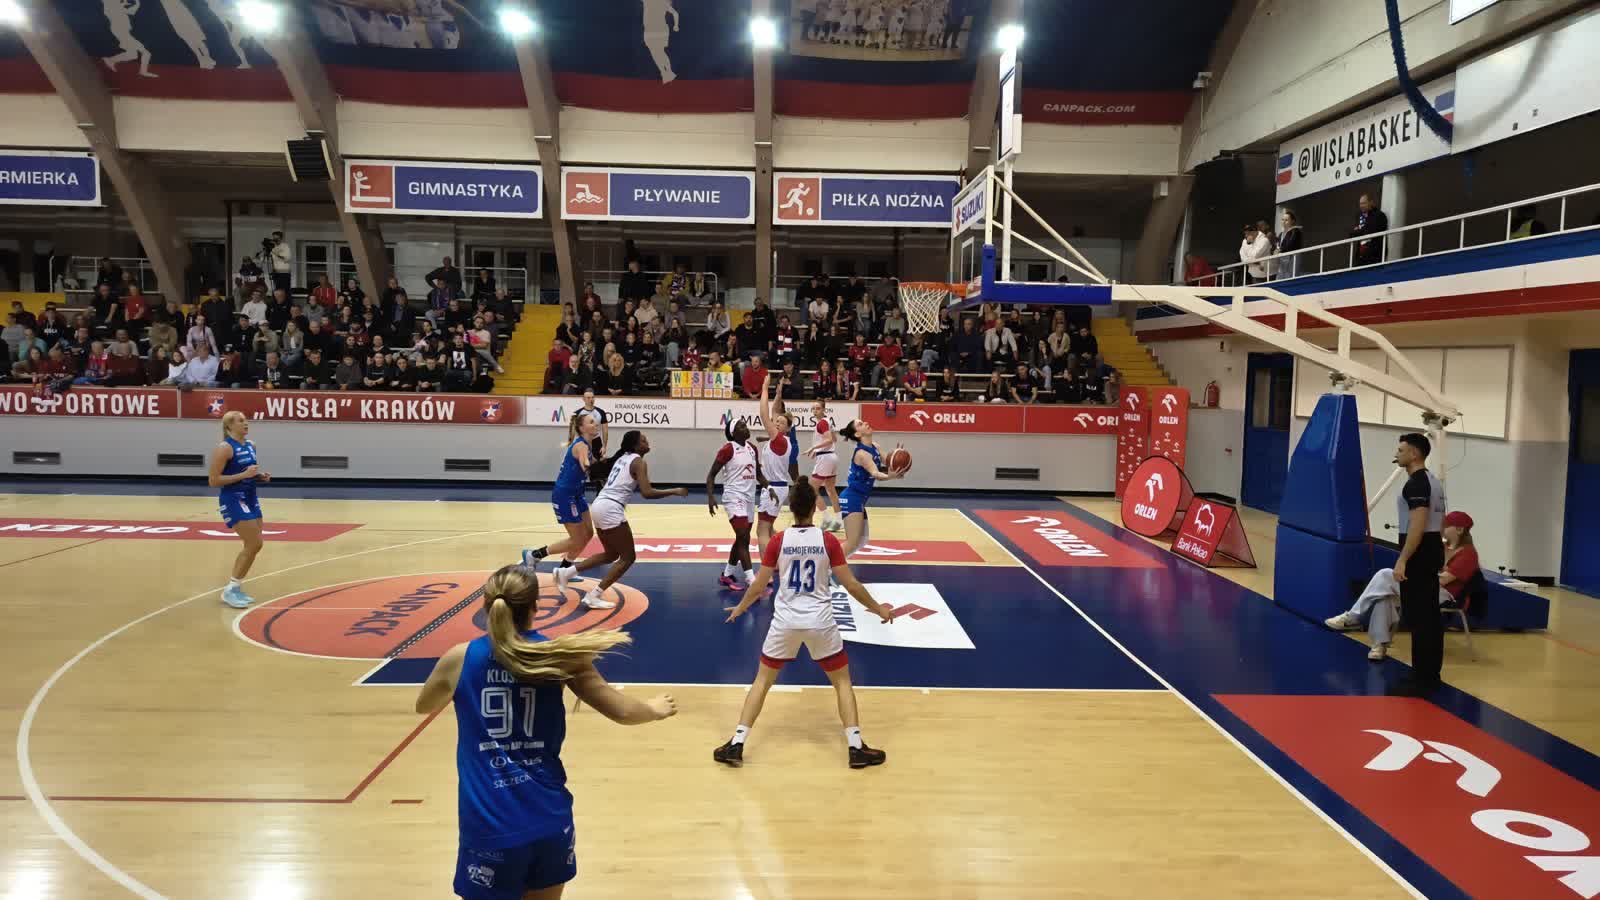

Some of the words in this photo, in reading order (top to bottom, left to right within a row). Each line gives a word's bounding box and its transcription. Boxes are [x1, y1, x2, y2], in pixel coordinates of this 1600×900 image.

[1042, 103, 1136, 113] CANPACK.COM
[408, 181, 523, 198] GIMNASTYKA
[633, 188, 720, 203] PŁYWANIE
[832, 193, 881, 206] PIŁKA
[885, 192, 945, 207] NOŻNA
[961, 190, 984, 224] SUZUKI
[359, 396, 456, 421] KRAKÓW
[605, 411, 670, 425] OPOLSKA
[933, 412, 975, 424] ORLEN
[1158, 415, 1179, 425] ORLEN
[1133, 503, 1158, 521] ORLEN
[1033, 527, 1109, 557] ORLEN
[1176, 537, 1192, 553] Bank
[1189, 541, 1208, 560] Pekao
[782, 546, 825, 556] NIEMOJEWSKA
[787, 559, 816, 595] 43
[343, 582, 459, 637] CANPACK
[480, 686, 537, 739] 91
